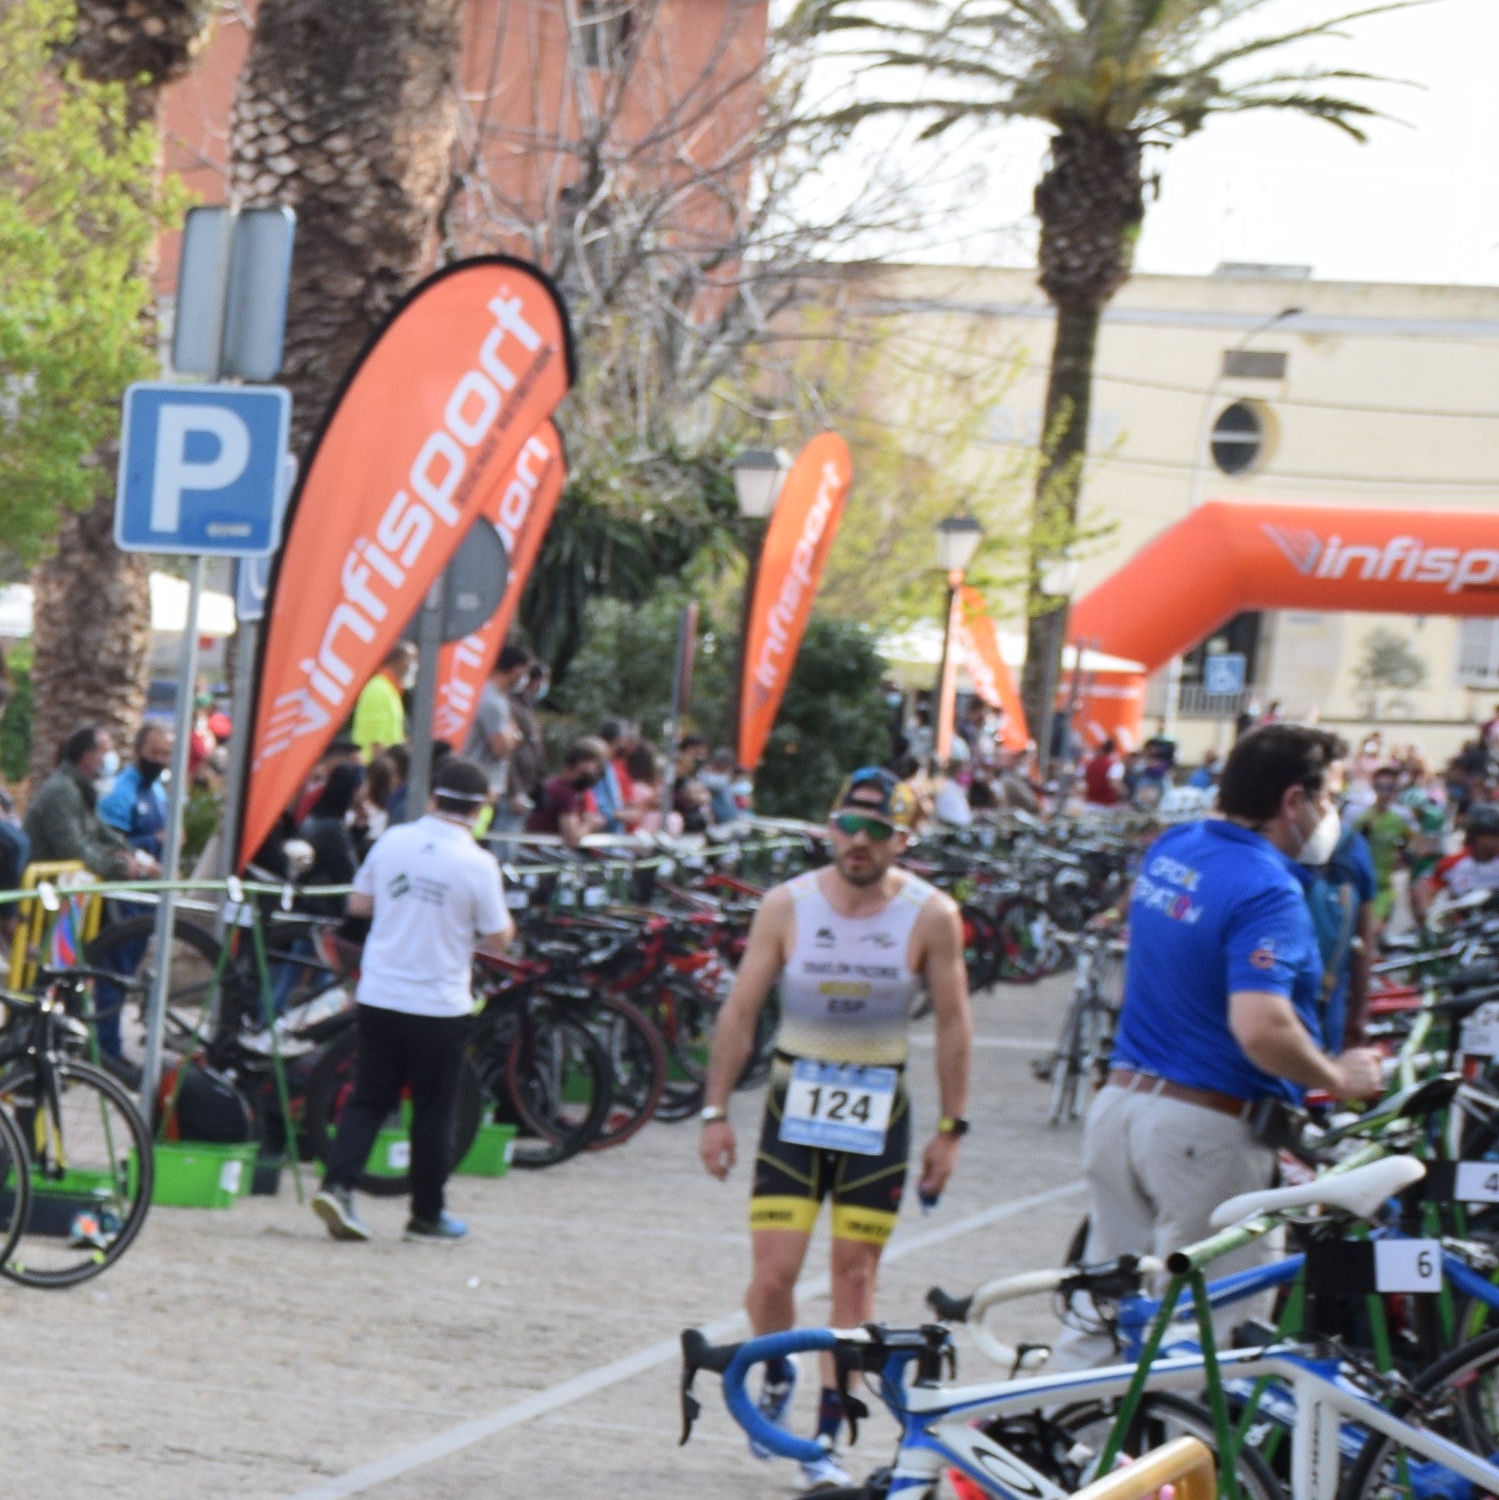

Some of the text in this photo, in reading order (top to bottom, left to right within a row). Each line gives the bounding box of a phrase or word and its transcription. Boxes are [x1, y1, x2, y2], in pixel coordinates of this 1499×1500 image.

[150, 404, 251, 534] P
[300, 288, 542, 707] infisport
[808, 1086, 872, 1124] 124
[1417, 1250, 1433, 1279] 6
